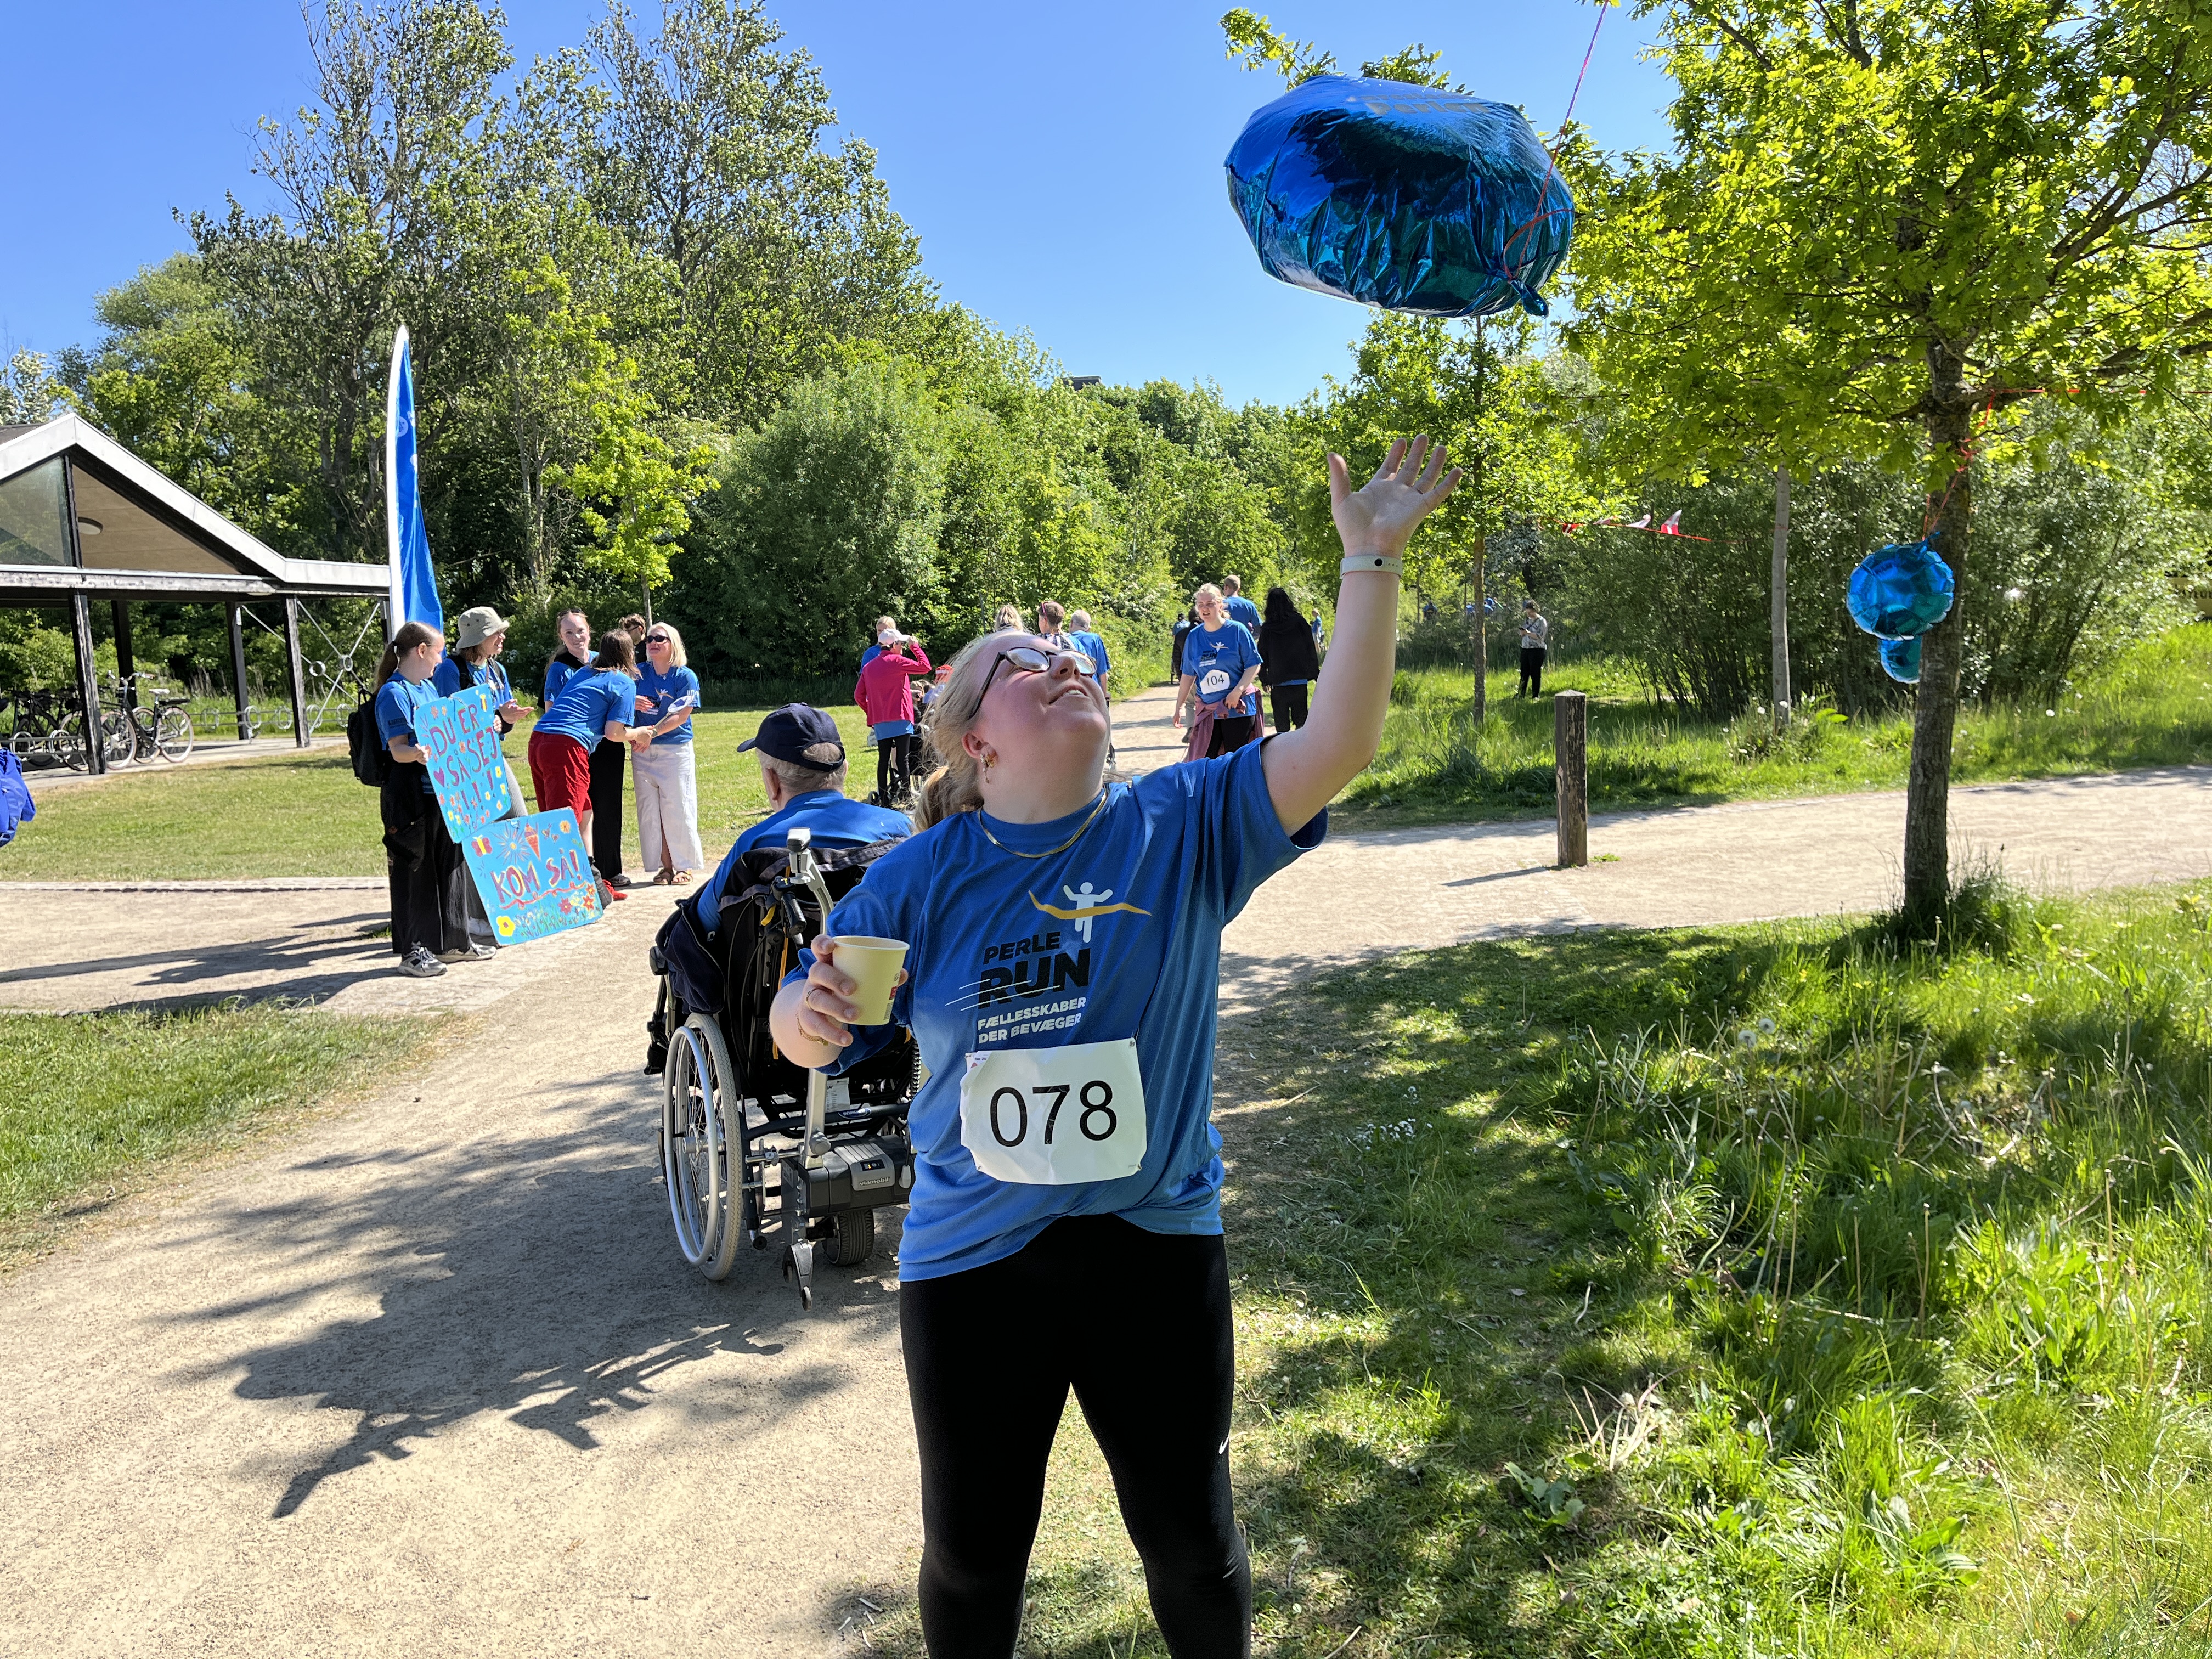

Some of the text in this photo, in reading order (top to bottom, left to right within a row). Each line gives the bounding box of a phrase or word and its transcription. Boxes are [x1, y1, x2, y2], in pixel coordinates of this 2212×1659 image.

[1365, 101, 1492, 115] Perlen
[1207, 674, 1224, 687] 104
[429, 704, 480, 757] DU ER
[467, 727, 498, 774] SEJ
[490, 848, 582, 904] KOM SÅ!
[983, 931, 1061, 965] PERLE
[978, 948, 1091, 1009] RUN
[978, 997, 1087, 1031] FÆLLESSKABER
[978, 1013, 1082, 1044] DER BEVÆGER
[990, 1080, 1118, 1147] 078
[860, 1177, 889, 1186] viamobil
